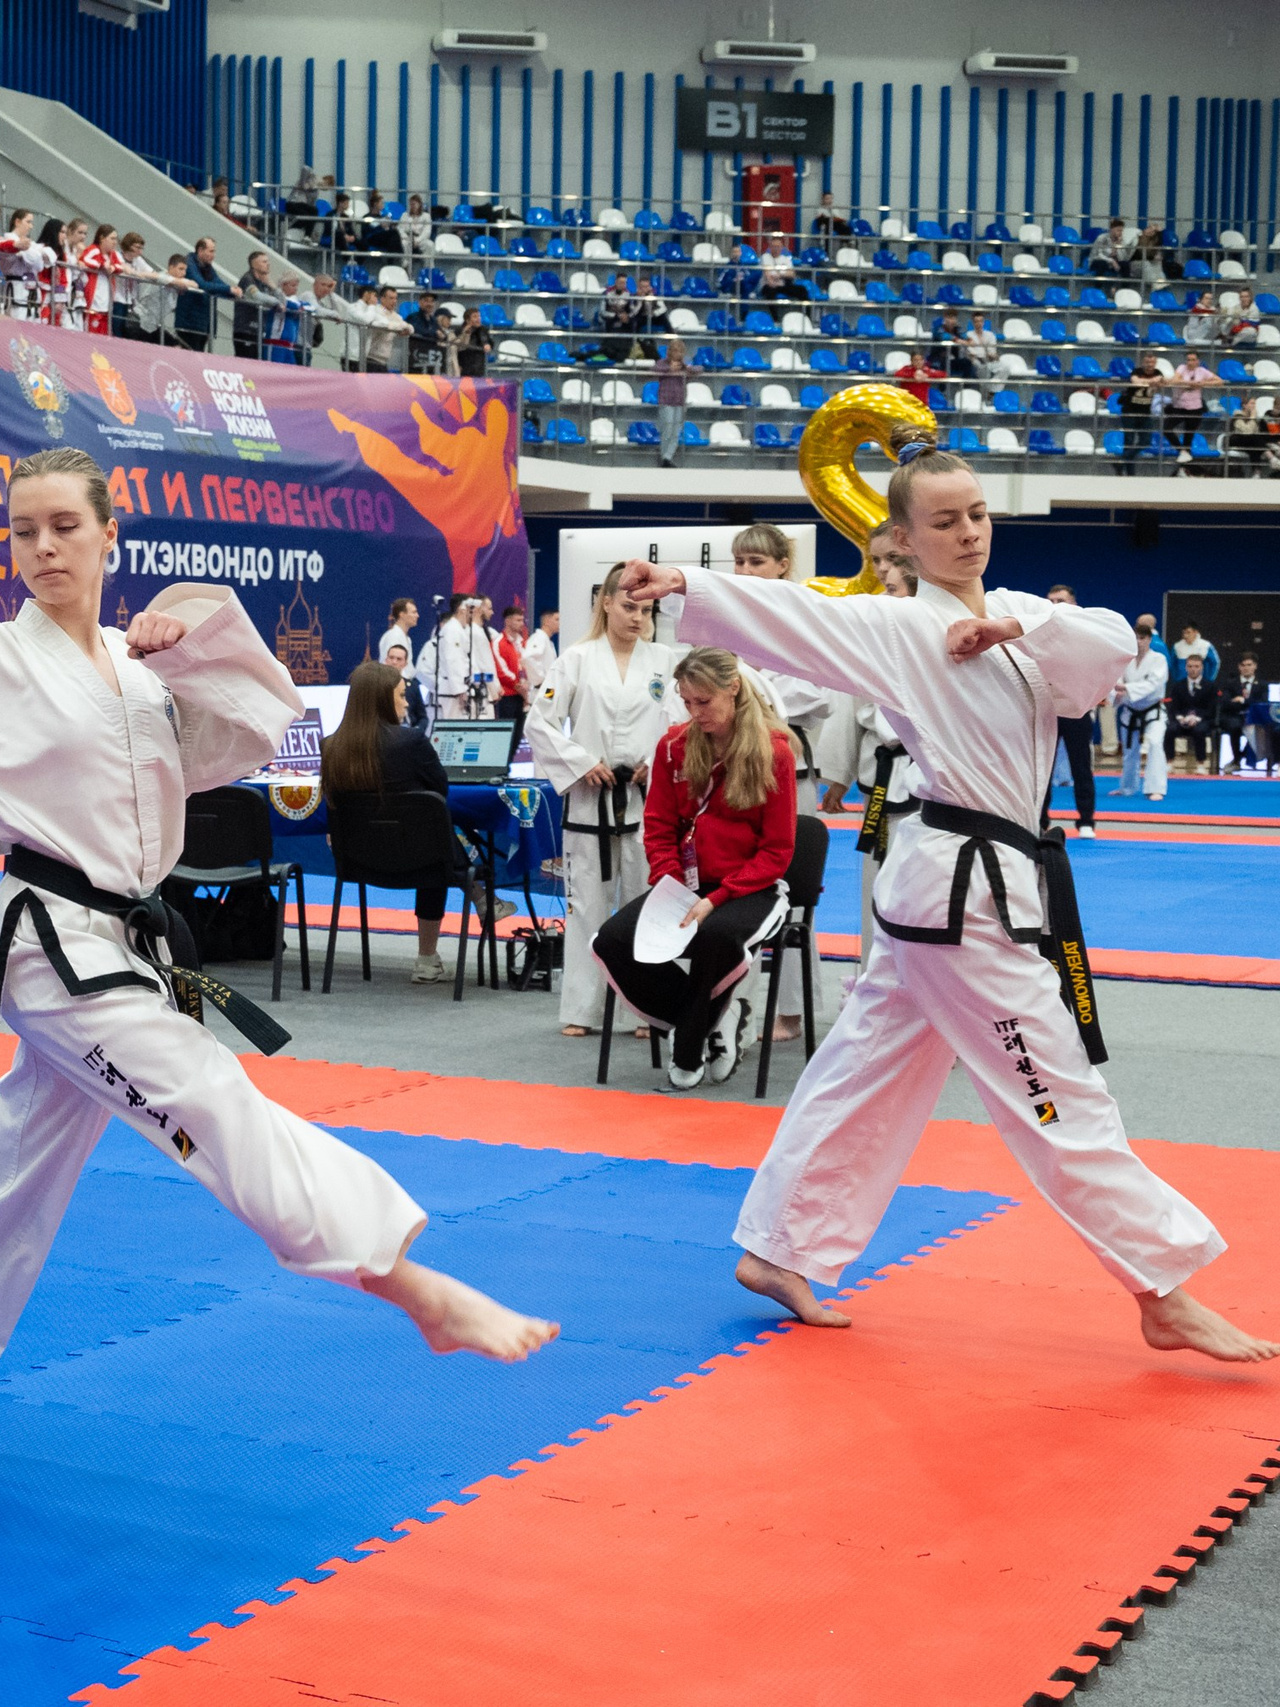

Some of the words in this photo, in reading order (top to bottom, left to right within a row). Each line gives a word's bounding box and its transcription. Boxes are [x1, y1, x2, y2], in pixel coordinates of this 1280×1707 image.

[762, 116, 807, 127] СЕКТОР
[762, 130, 806, 140] SECTOR
[202, 368, 248, 393] СПОРТ
[211, 390, 268, 417] НОРМА
[221, 412, 277, 439] ЖИЗНИ
[161, 471, 193, 518] И
[200, 474, 396, 533] ПЕРВЕНСТВО
[125, 540, 273, 586] ТХЭКВОНДО
[279, 550, 325, 582] ИТФ
[862, 785, 887, 834] RUSSIA
[994, 1018, 1019, 1033] ITF
[82, 1044, 104, 1070] ITF
